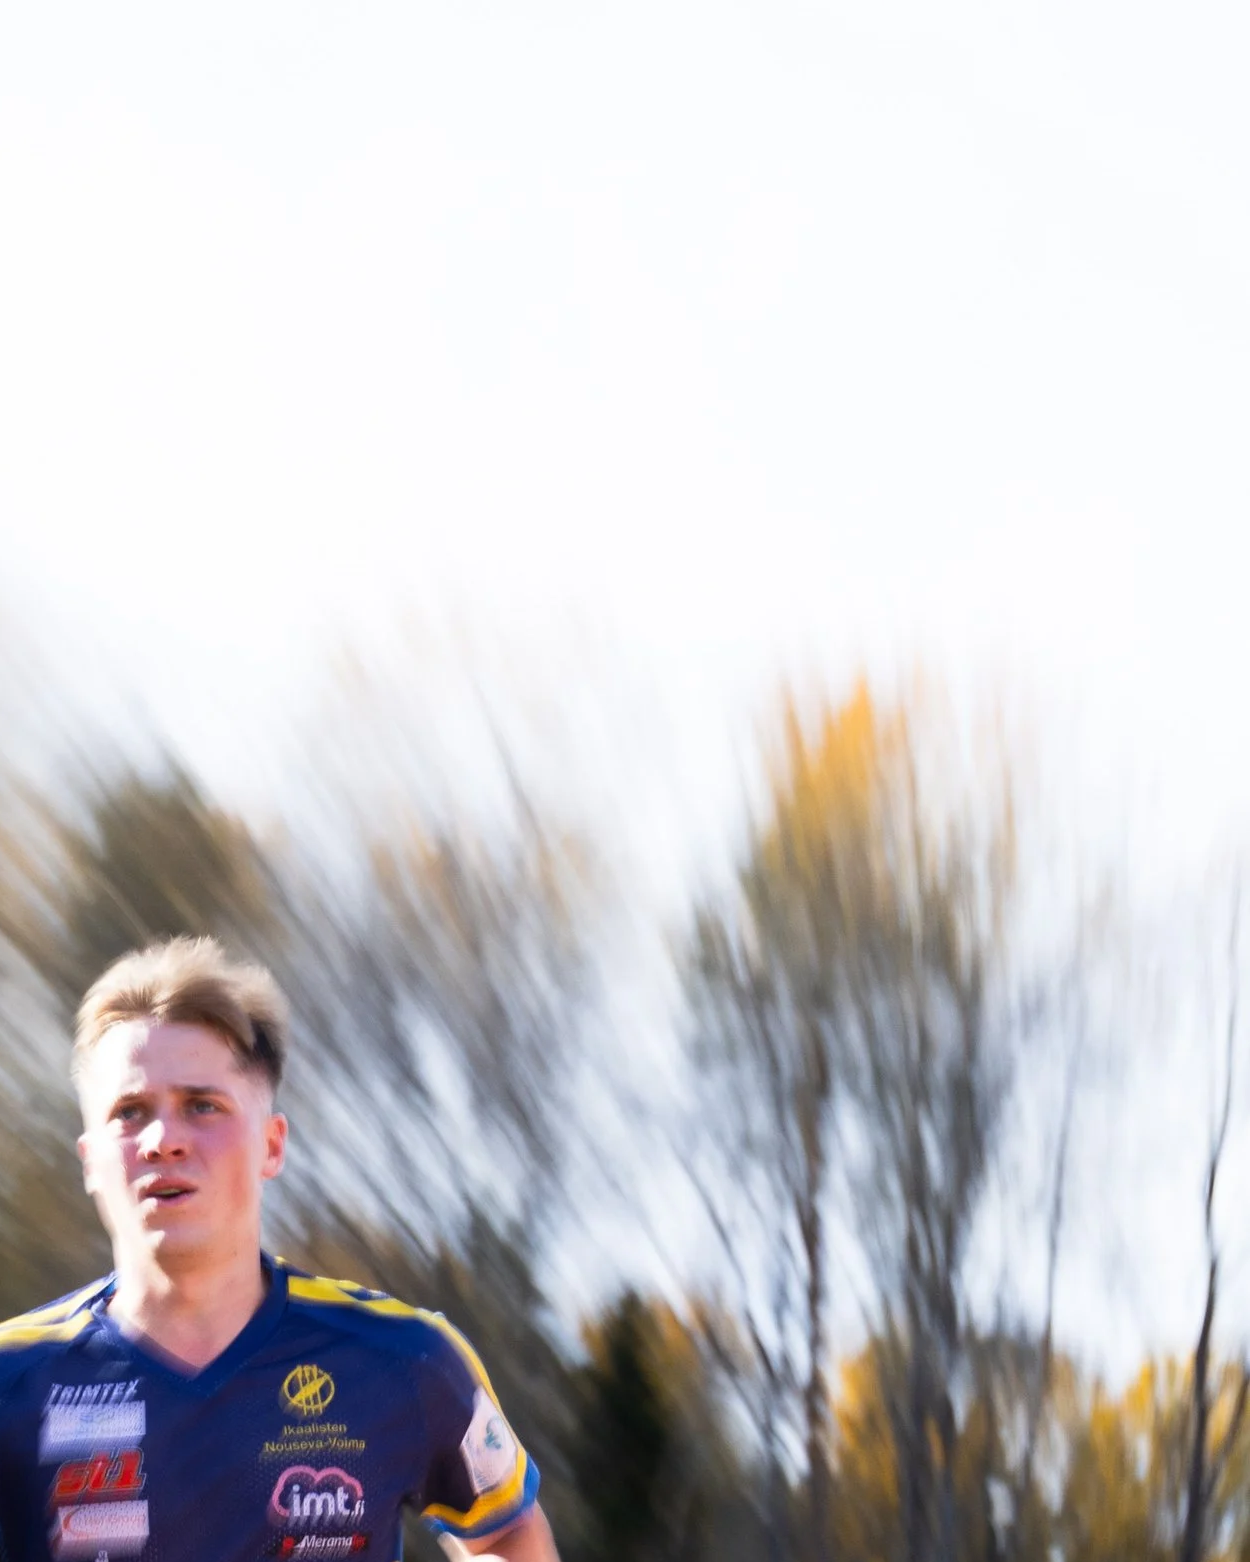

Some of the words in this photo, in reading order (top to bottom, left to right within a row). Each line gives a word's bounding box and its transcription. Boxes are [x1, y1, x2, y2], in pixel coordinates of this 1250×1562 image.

[46, 1379, 140, 1405] TRIMTEX
[283, 1422, 347, 1435] Ikaalisten
[264, 1437, 366, 1453] Nouseva-Voima
